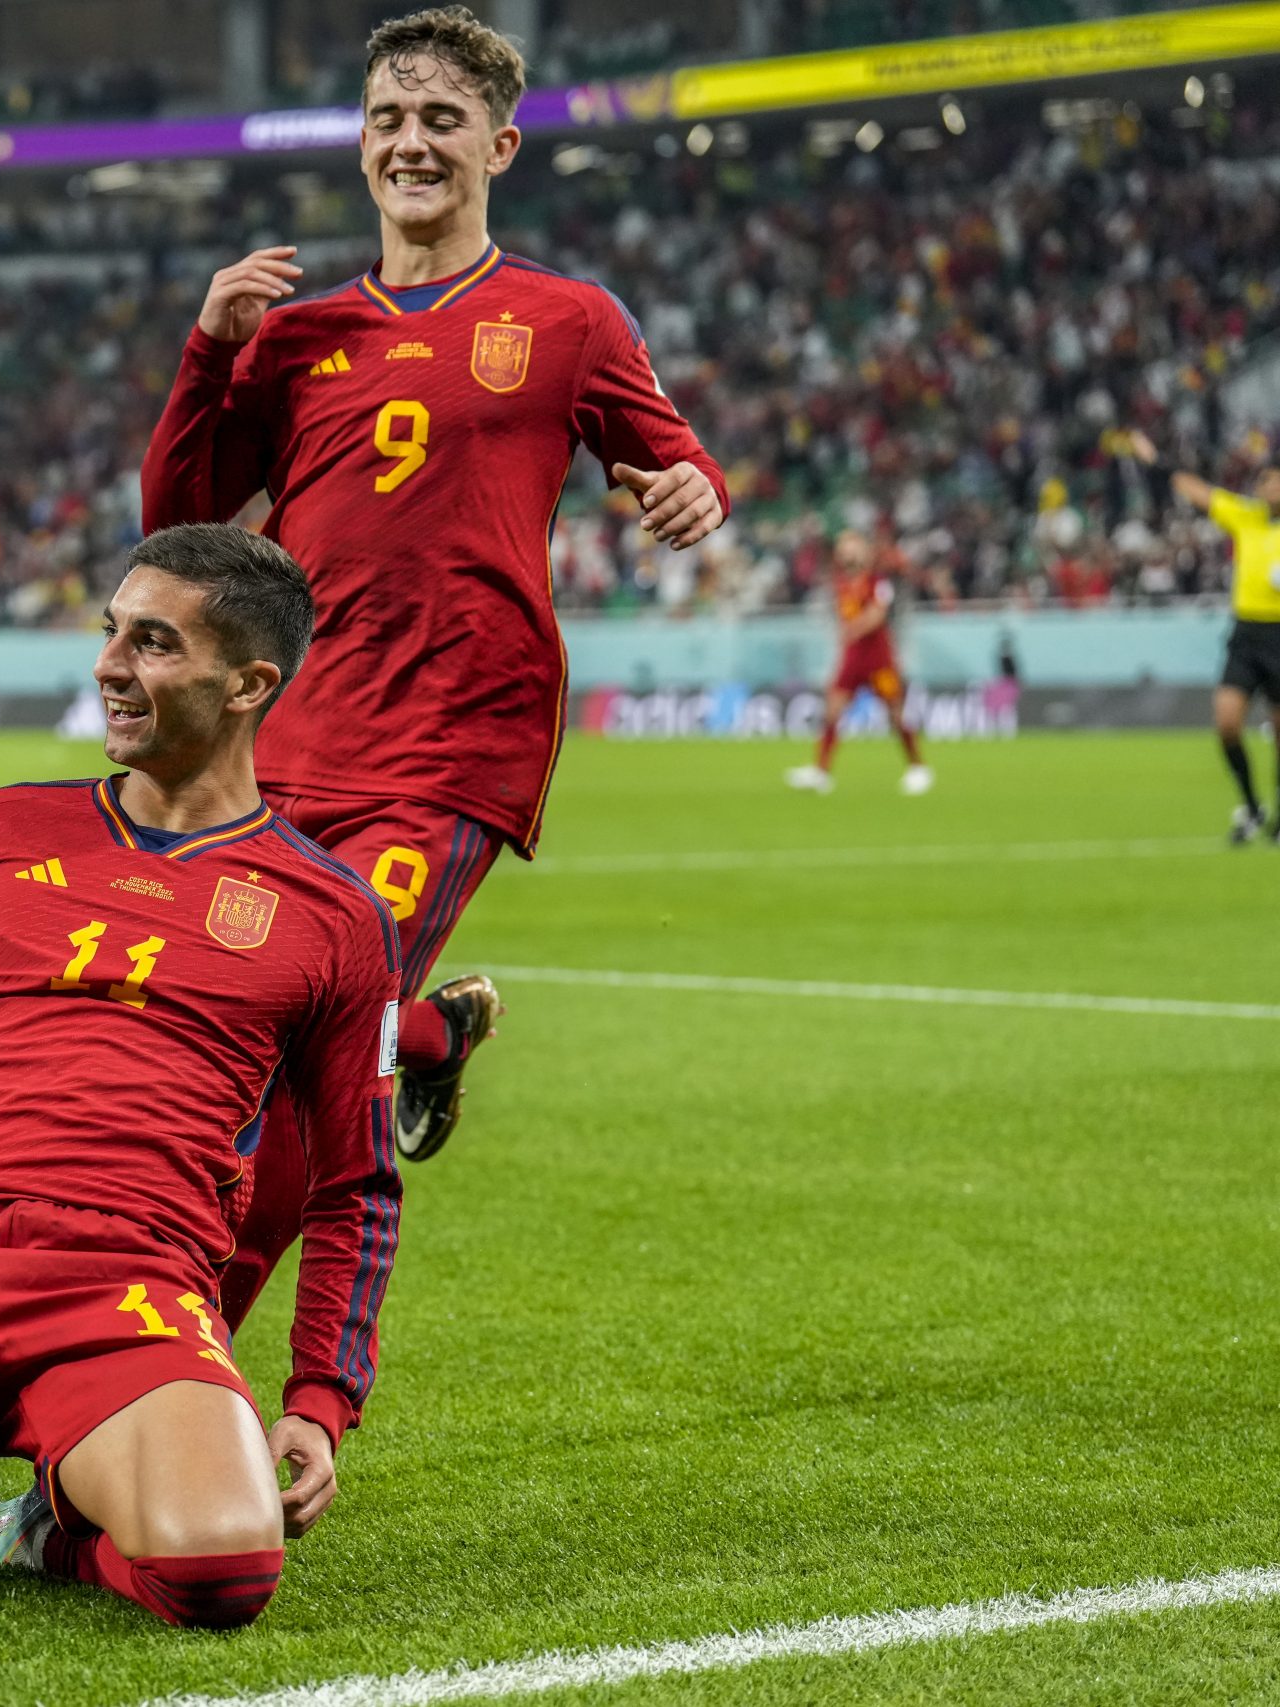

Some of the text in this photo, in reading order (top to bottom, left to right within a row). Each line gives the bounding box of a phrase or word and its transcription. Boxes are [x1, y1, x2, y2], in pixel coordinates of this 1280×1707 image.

[374, 400, 430, 493] 9
[125, 881, 156, 891] NOVEMBER
[157, 888, 174, 896] 2022
[129, 876, 147, 884] COSTA
[148, 891, 175, 901] STADIUM
[370, 846, 429, 922] 9
[50, 920, 166, 1009] 11
[116, 1283, 228, 1356] 11
